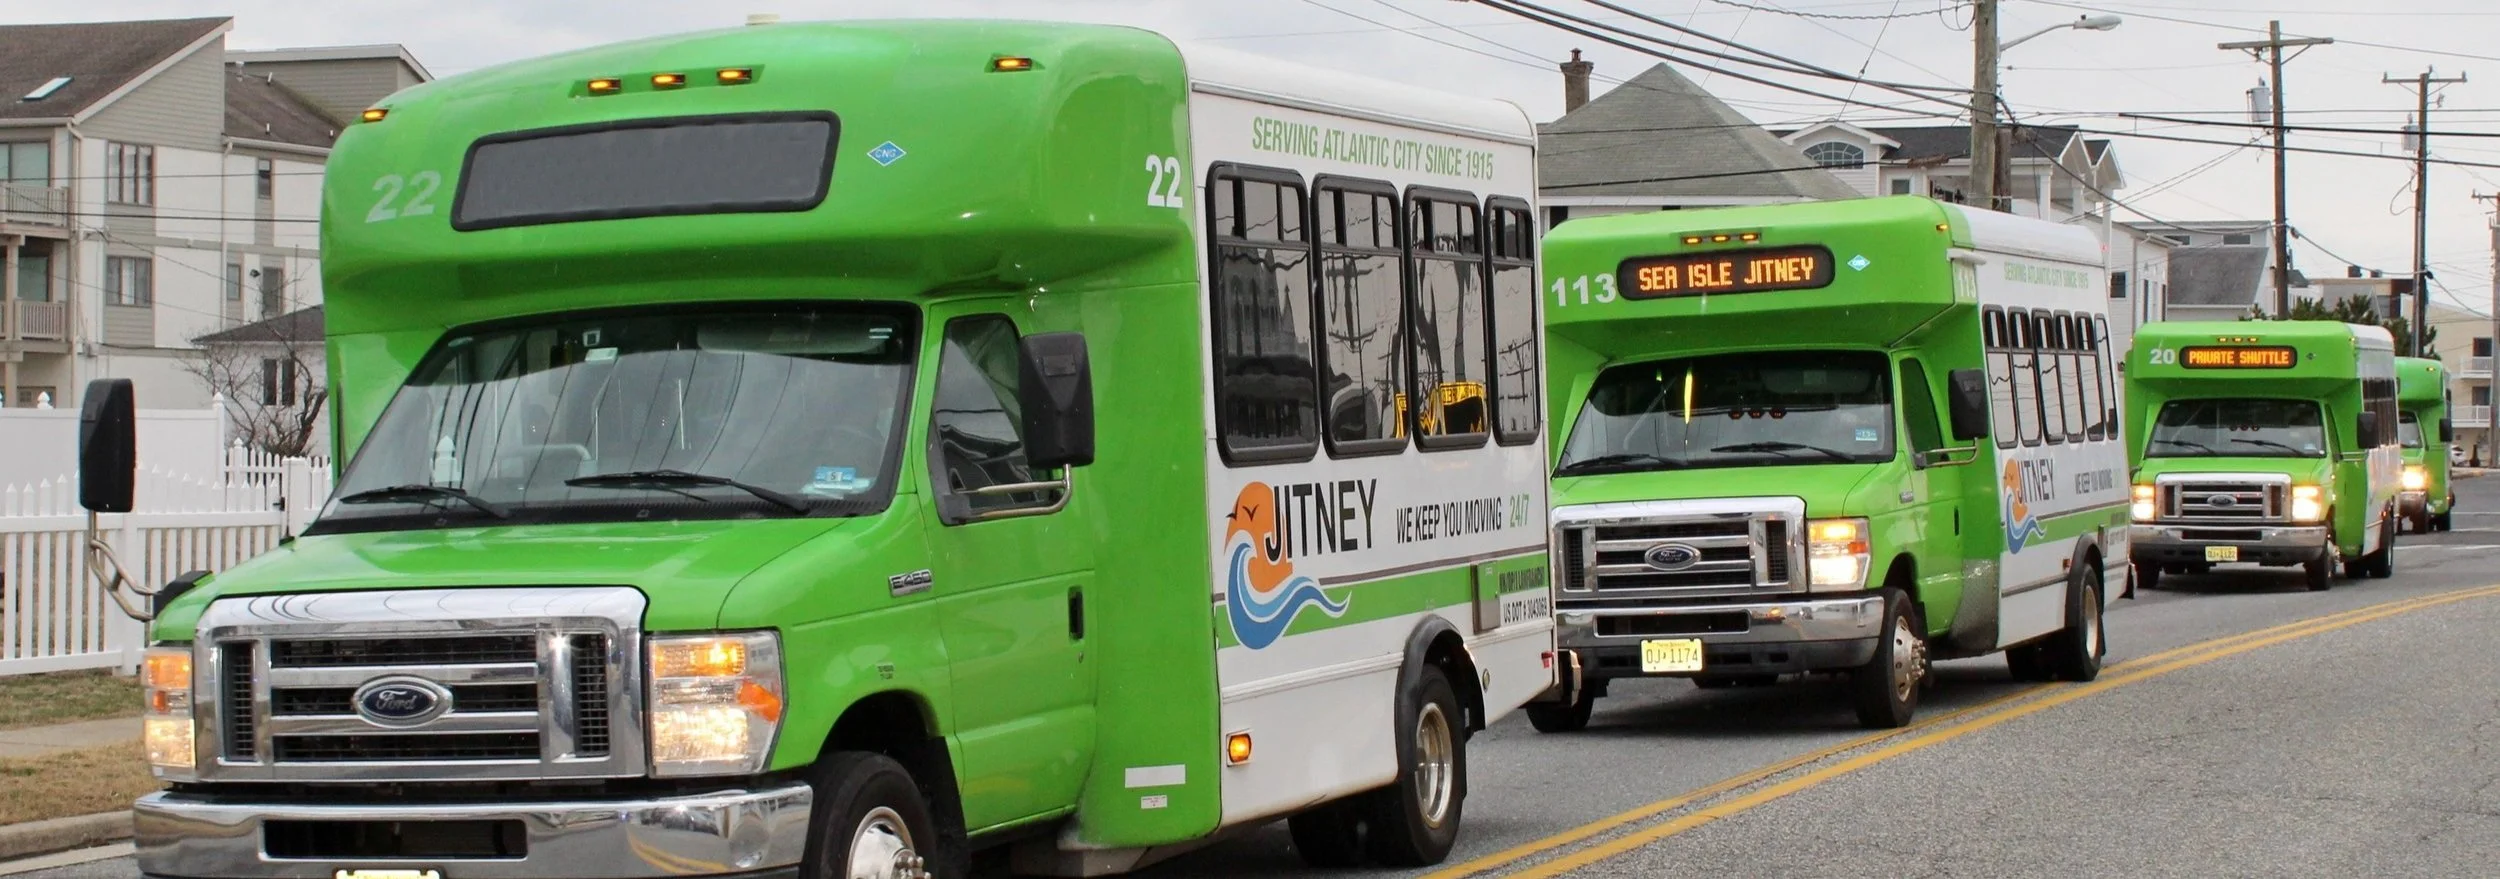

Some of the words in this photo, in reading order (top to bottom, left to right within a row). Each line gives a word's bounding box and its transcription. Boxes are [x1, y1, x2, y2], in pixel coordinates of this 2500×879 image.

[1252, 116, 1319, 157] SERVING
[1322, 128, 1390, 168] ATLANTIC
[1393, 139, 1422, 171] CITY
[1425, 143, 1461, 176] SINCE
[1465, 148, 1494, 180] 1915
[364, 170, 442, 224] 22
[1145, 154, 1184, 208] 22
[1551, 273, 1617, 307] 113
[1638, 267, 1678, 291] SEA
[1688, 262, 1733, 287] ISLE
[1743, 256, 1815, 285] JITNEY
[2150, 348, 2176, 365] 20
[2188, 350, 2235, 364] PRIVATE
[2239, 350, 2290, 364] SHUTTLE
[2017, 458, 2055, 504] JITNEY
[1265, 478, 1377, 562] JITNEY
[1396, 507, 1412, 544] WE
[1415, 504, 1441, 542] KEEP
[1443, 501, 1462, 538] YOU
[1465, 497, 1502, 535] MOVING
[1509, 493, 1530, 528] 24/7
[1503, 602, 1511, 623] US
[1512, 600, 1522, 622] DOT
[375, 689, 418, 710] Ford
